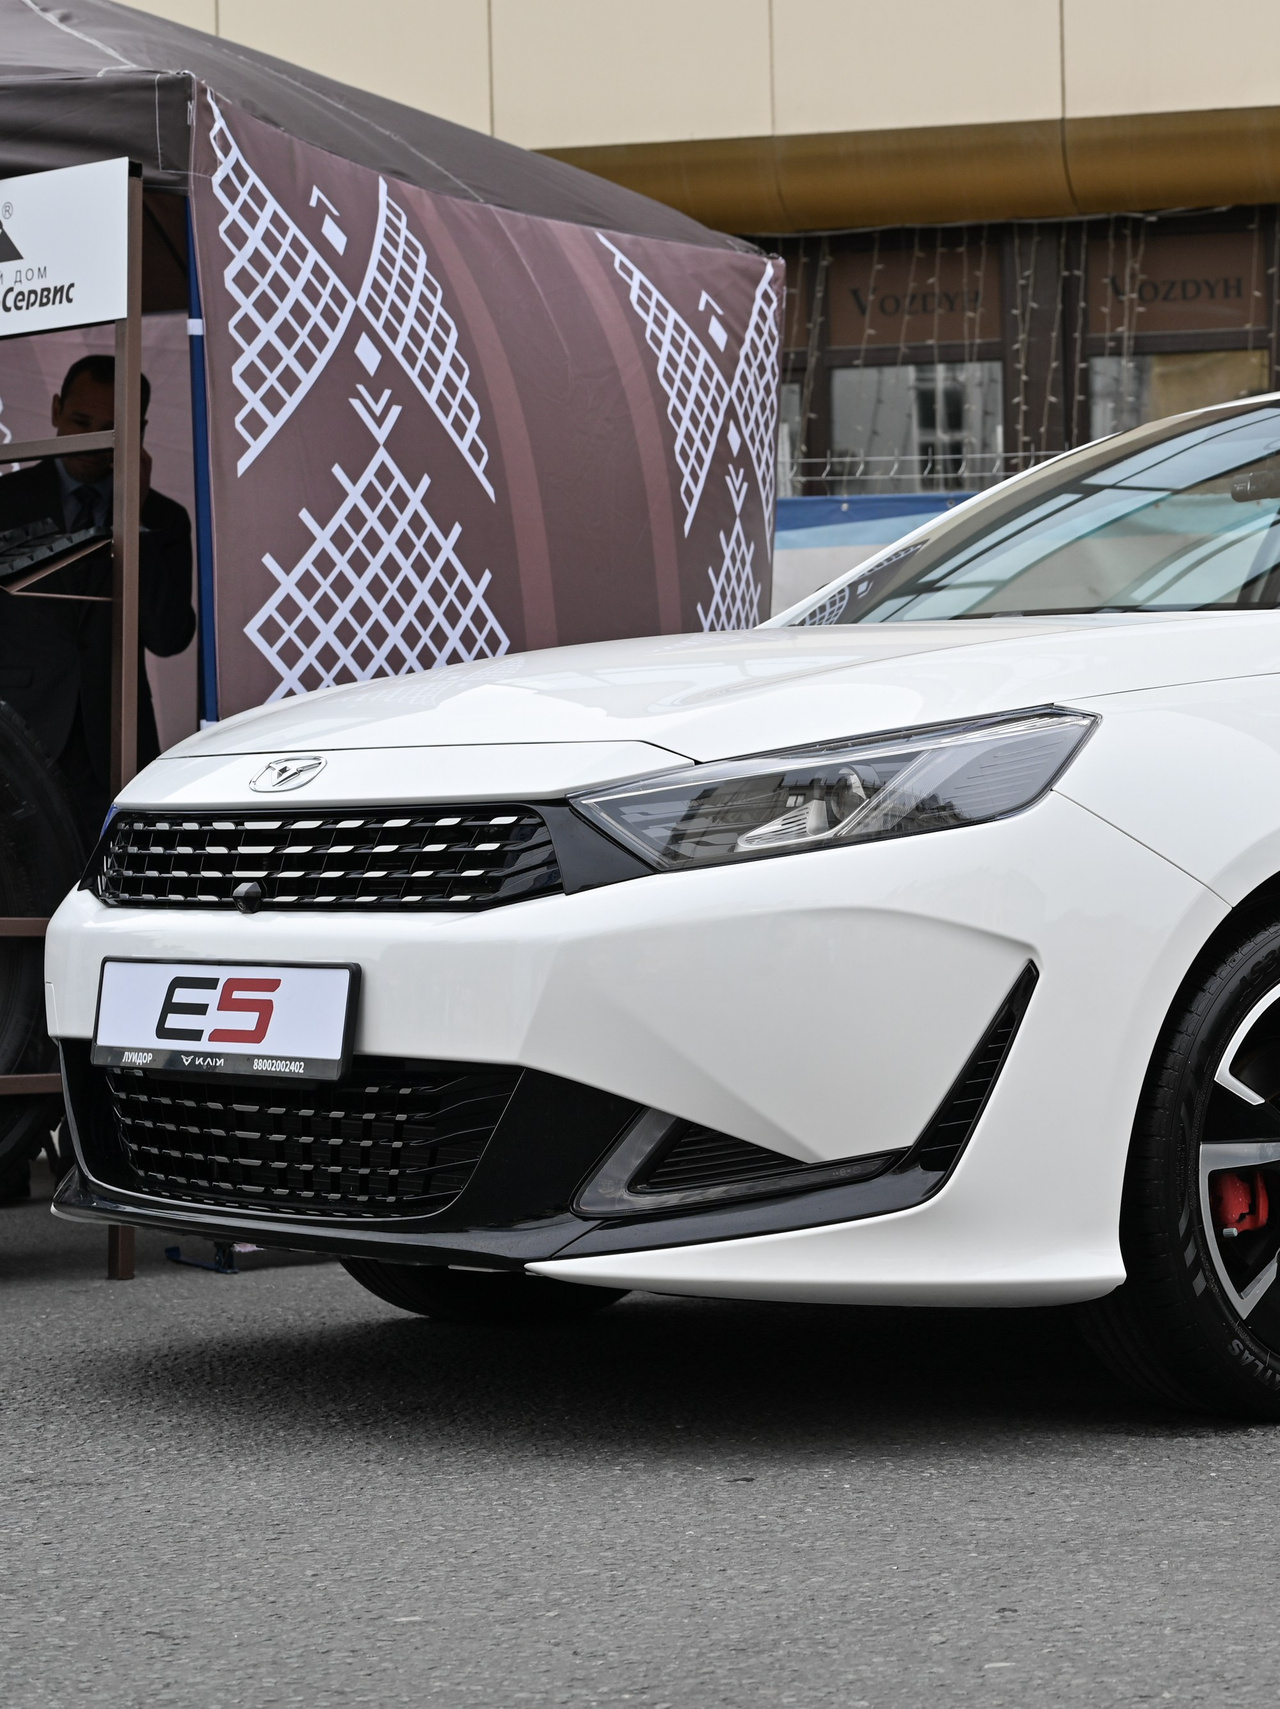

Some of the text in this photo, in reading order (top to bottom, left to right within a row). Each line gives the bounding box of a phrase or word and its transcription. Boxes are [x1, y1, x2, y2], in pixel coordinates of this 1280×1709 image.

[14, 266, 48, 285] ДОМ
[2, 282, 76, 313] Сервис
[122, 1051, 153, 1067] ЛУИДОР
[252, 1058, 305, 1074] 88002002402
